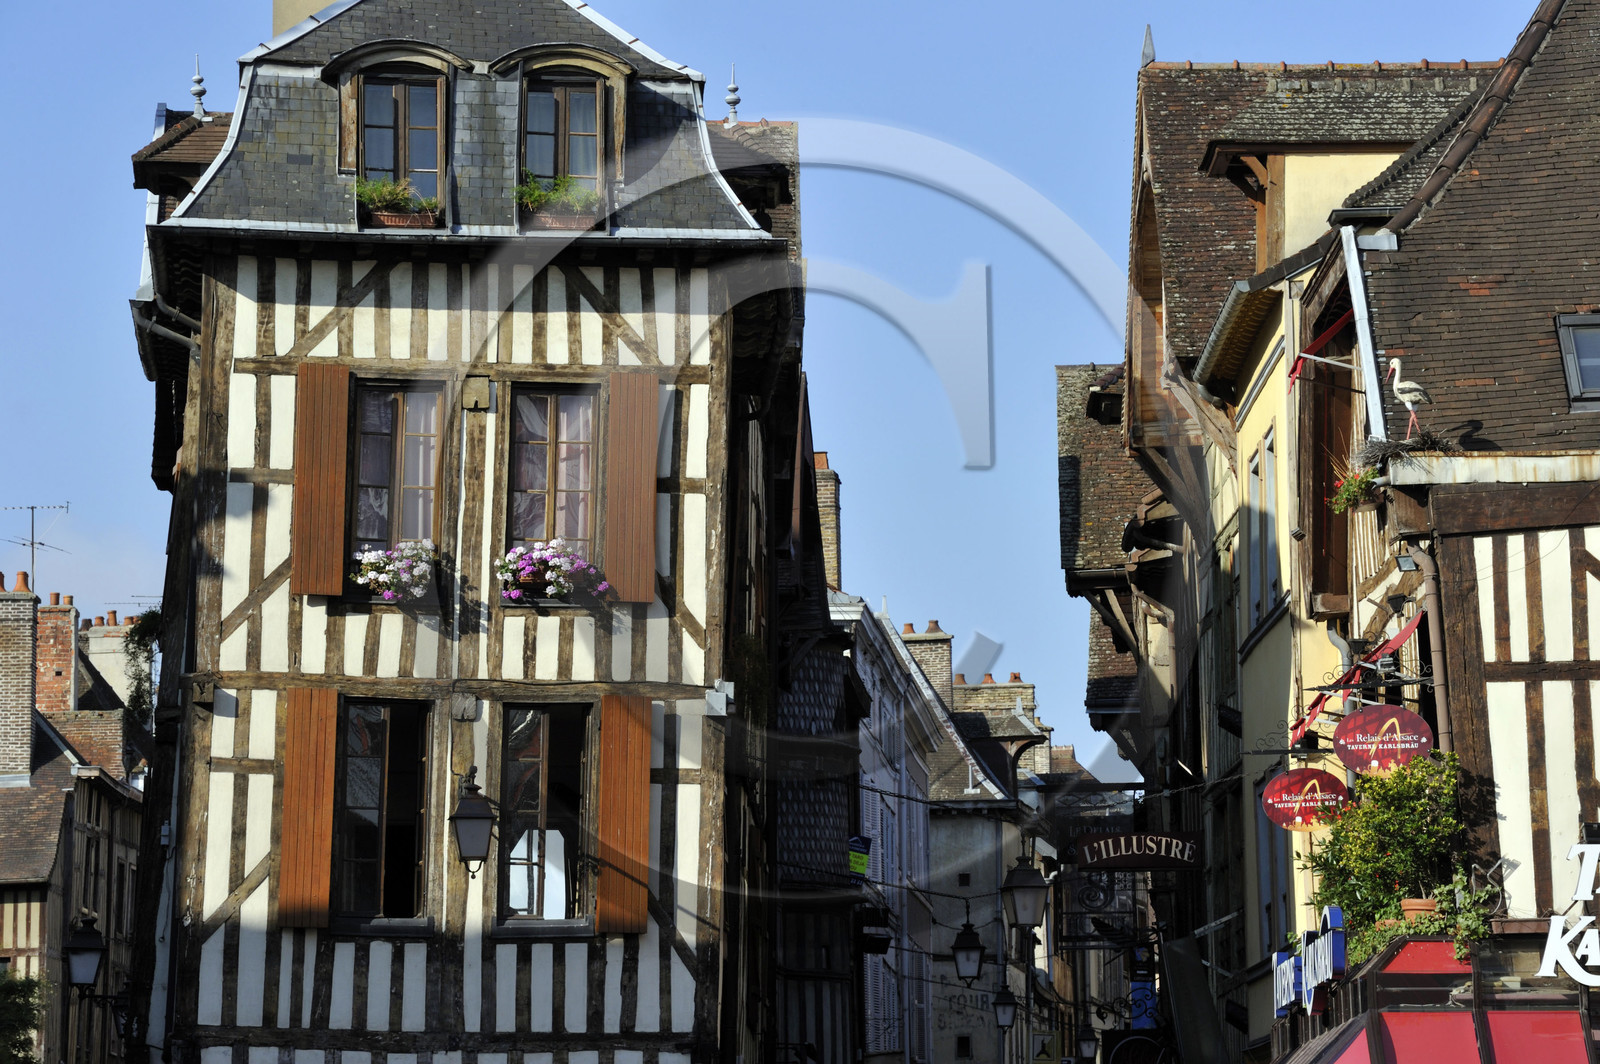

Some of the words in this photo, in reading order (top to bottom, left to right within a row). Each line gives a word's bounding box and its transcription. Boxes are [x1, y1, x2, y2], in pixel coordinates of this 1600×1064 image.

[1356, 733, 1381, 743] Relais
[1383, 733, 1419, 742] d'Alsace
[1282, 793, 1304, 802] Relais
[1082, 834, 1197, 864] L'ILLUSTRÉ
[1566, 843, 1600, 901] T
